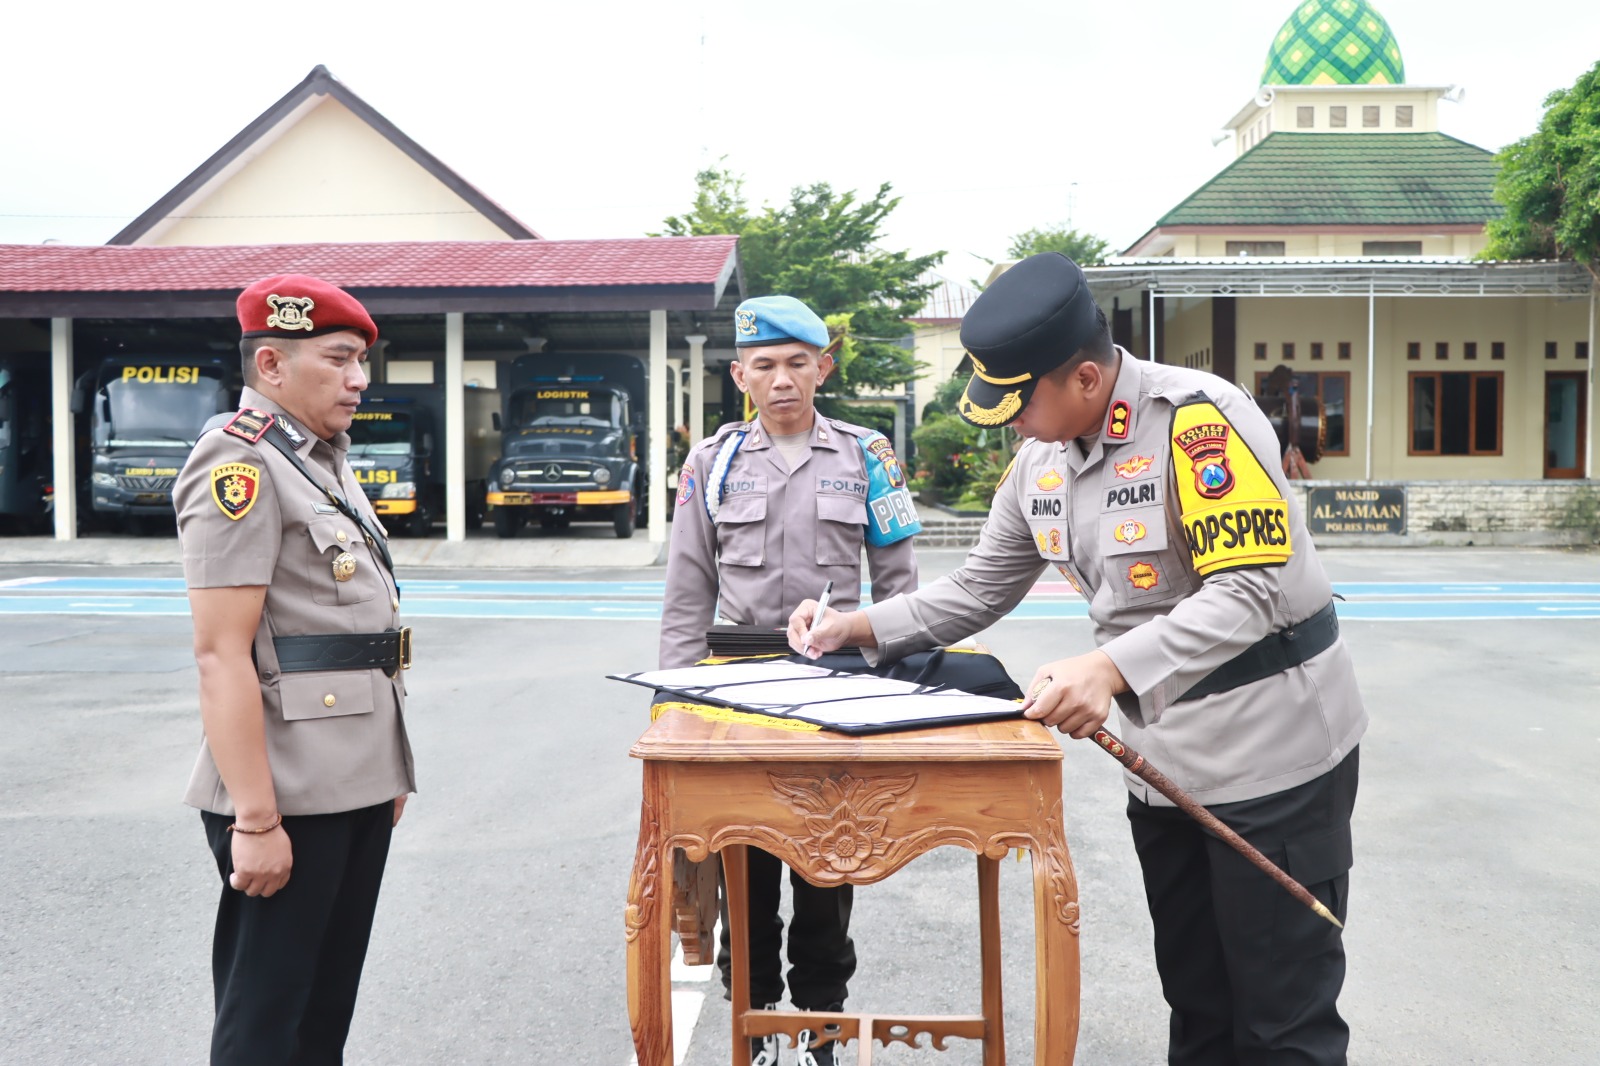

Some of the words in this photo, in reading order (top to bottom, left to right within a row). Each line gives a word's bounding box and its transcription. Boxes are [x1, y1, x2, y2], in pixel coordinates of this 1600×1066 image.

[122, 366, 199, 384] POLISI
[537, 390, 589, 399] LOGISTIK
[1179, 425, 1224, 442] POLRES
[1185, 430, 1222, 444] KEDIRI
[723, 480, 755, 494] BUDI
[821, 479, 866, 495] POLRI
[1106, 483, 1156, 508] POLRI
[1335, 490, 1380, 501] MASJID
[1031, 499, 1062, 517] BIMO
[1325, 523, 1362, 532] POLRES
